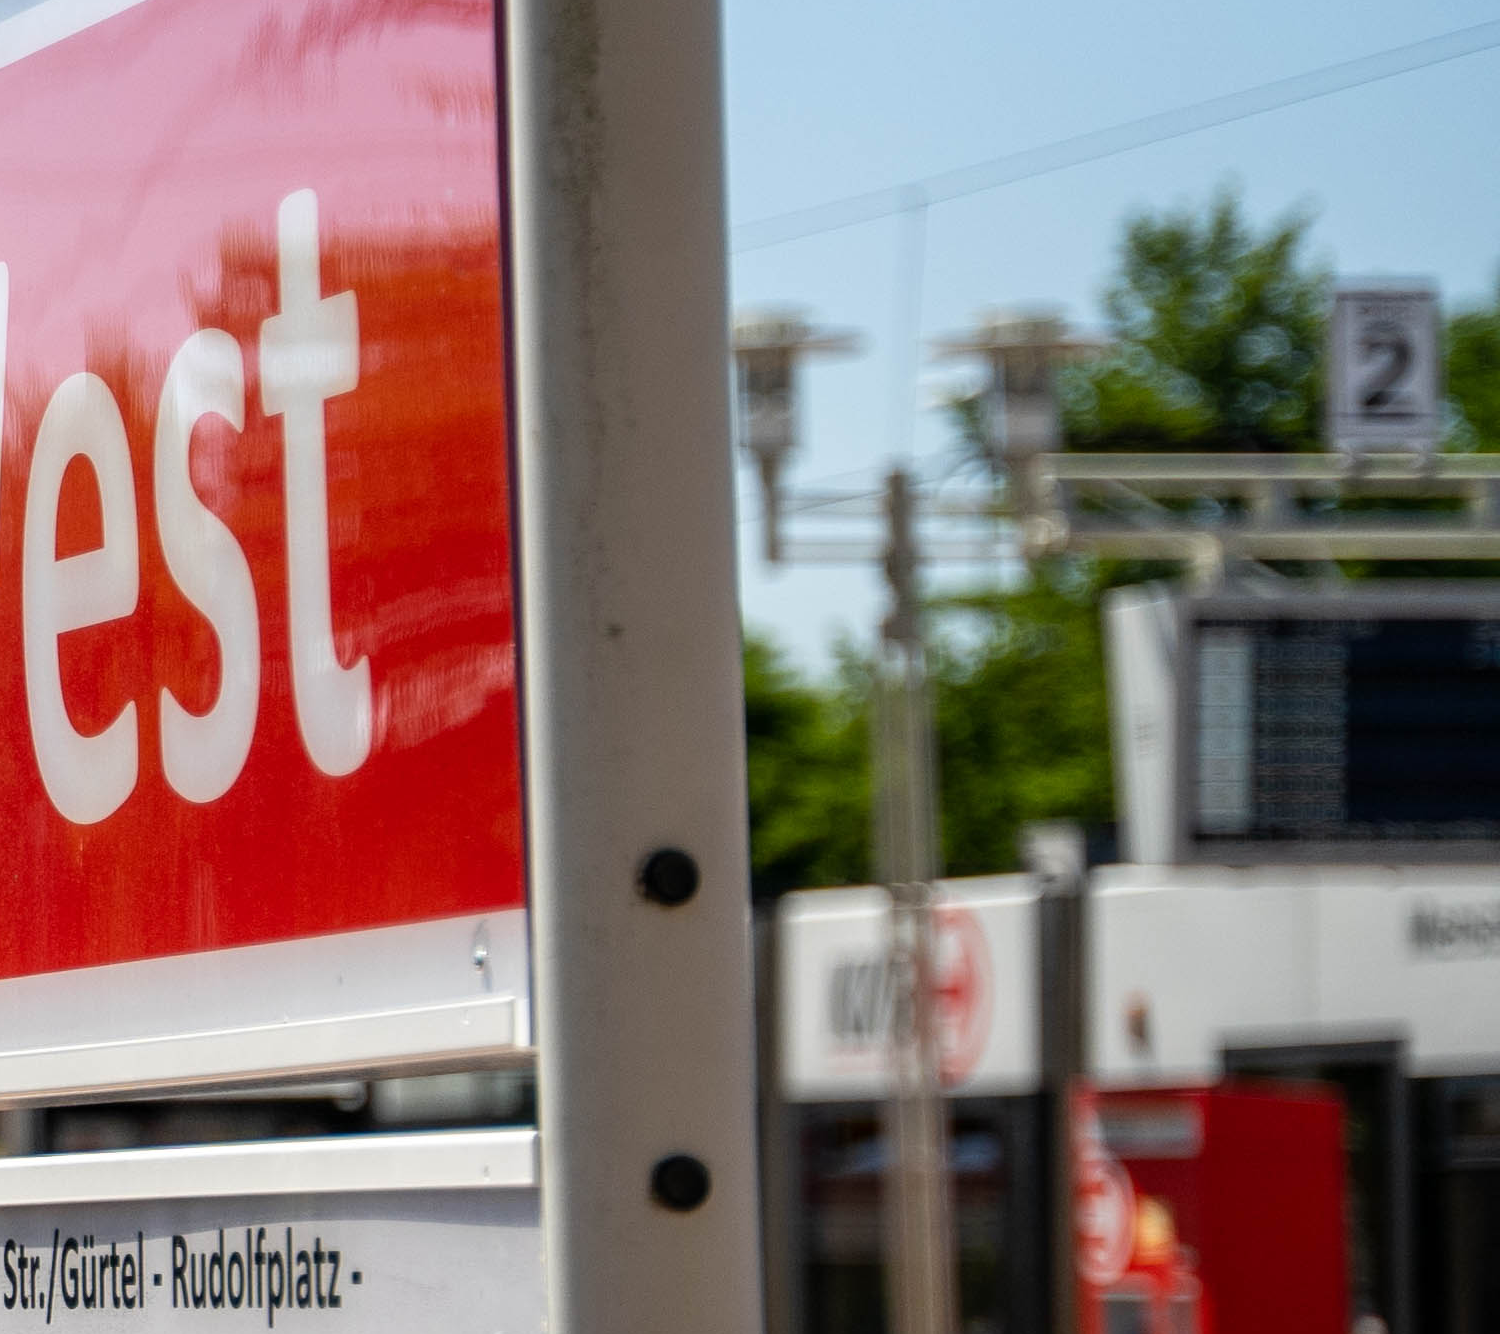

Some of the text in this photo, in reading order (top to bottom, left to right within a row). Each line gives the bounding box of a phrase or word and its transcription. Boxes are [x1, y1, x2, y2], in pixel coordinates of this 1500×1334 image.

[1360, 321, 1418, 423] 2
[3, 1228, 145, 1325] Str./Gürtel
[171, 1226, 343, 1329] Rudolfplatz
